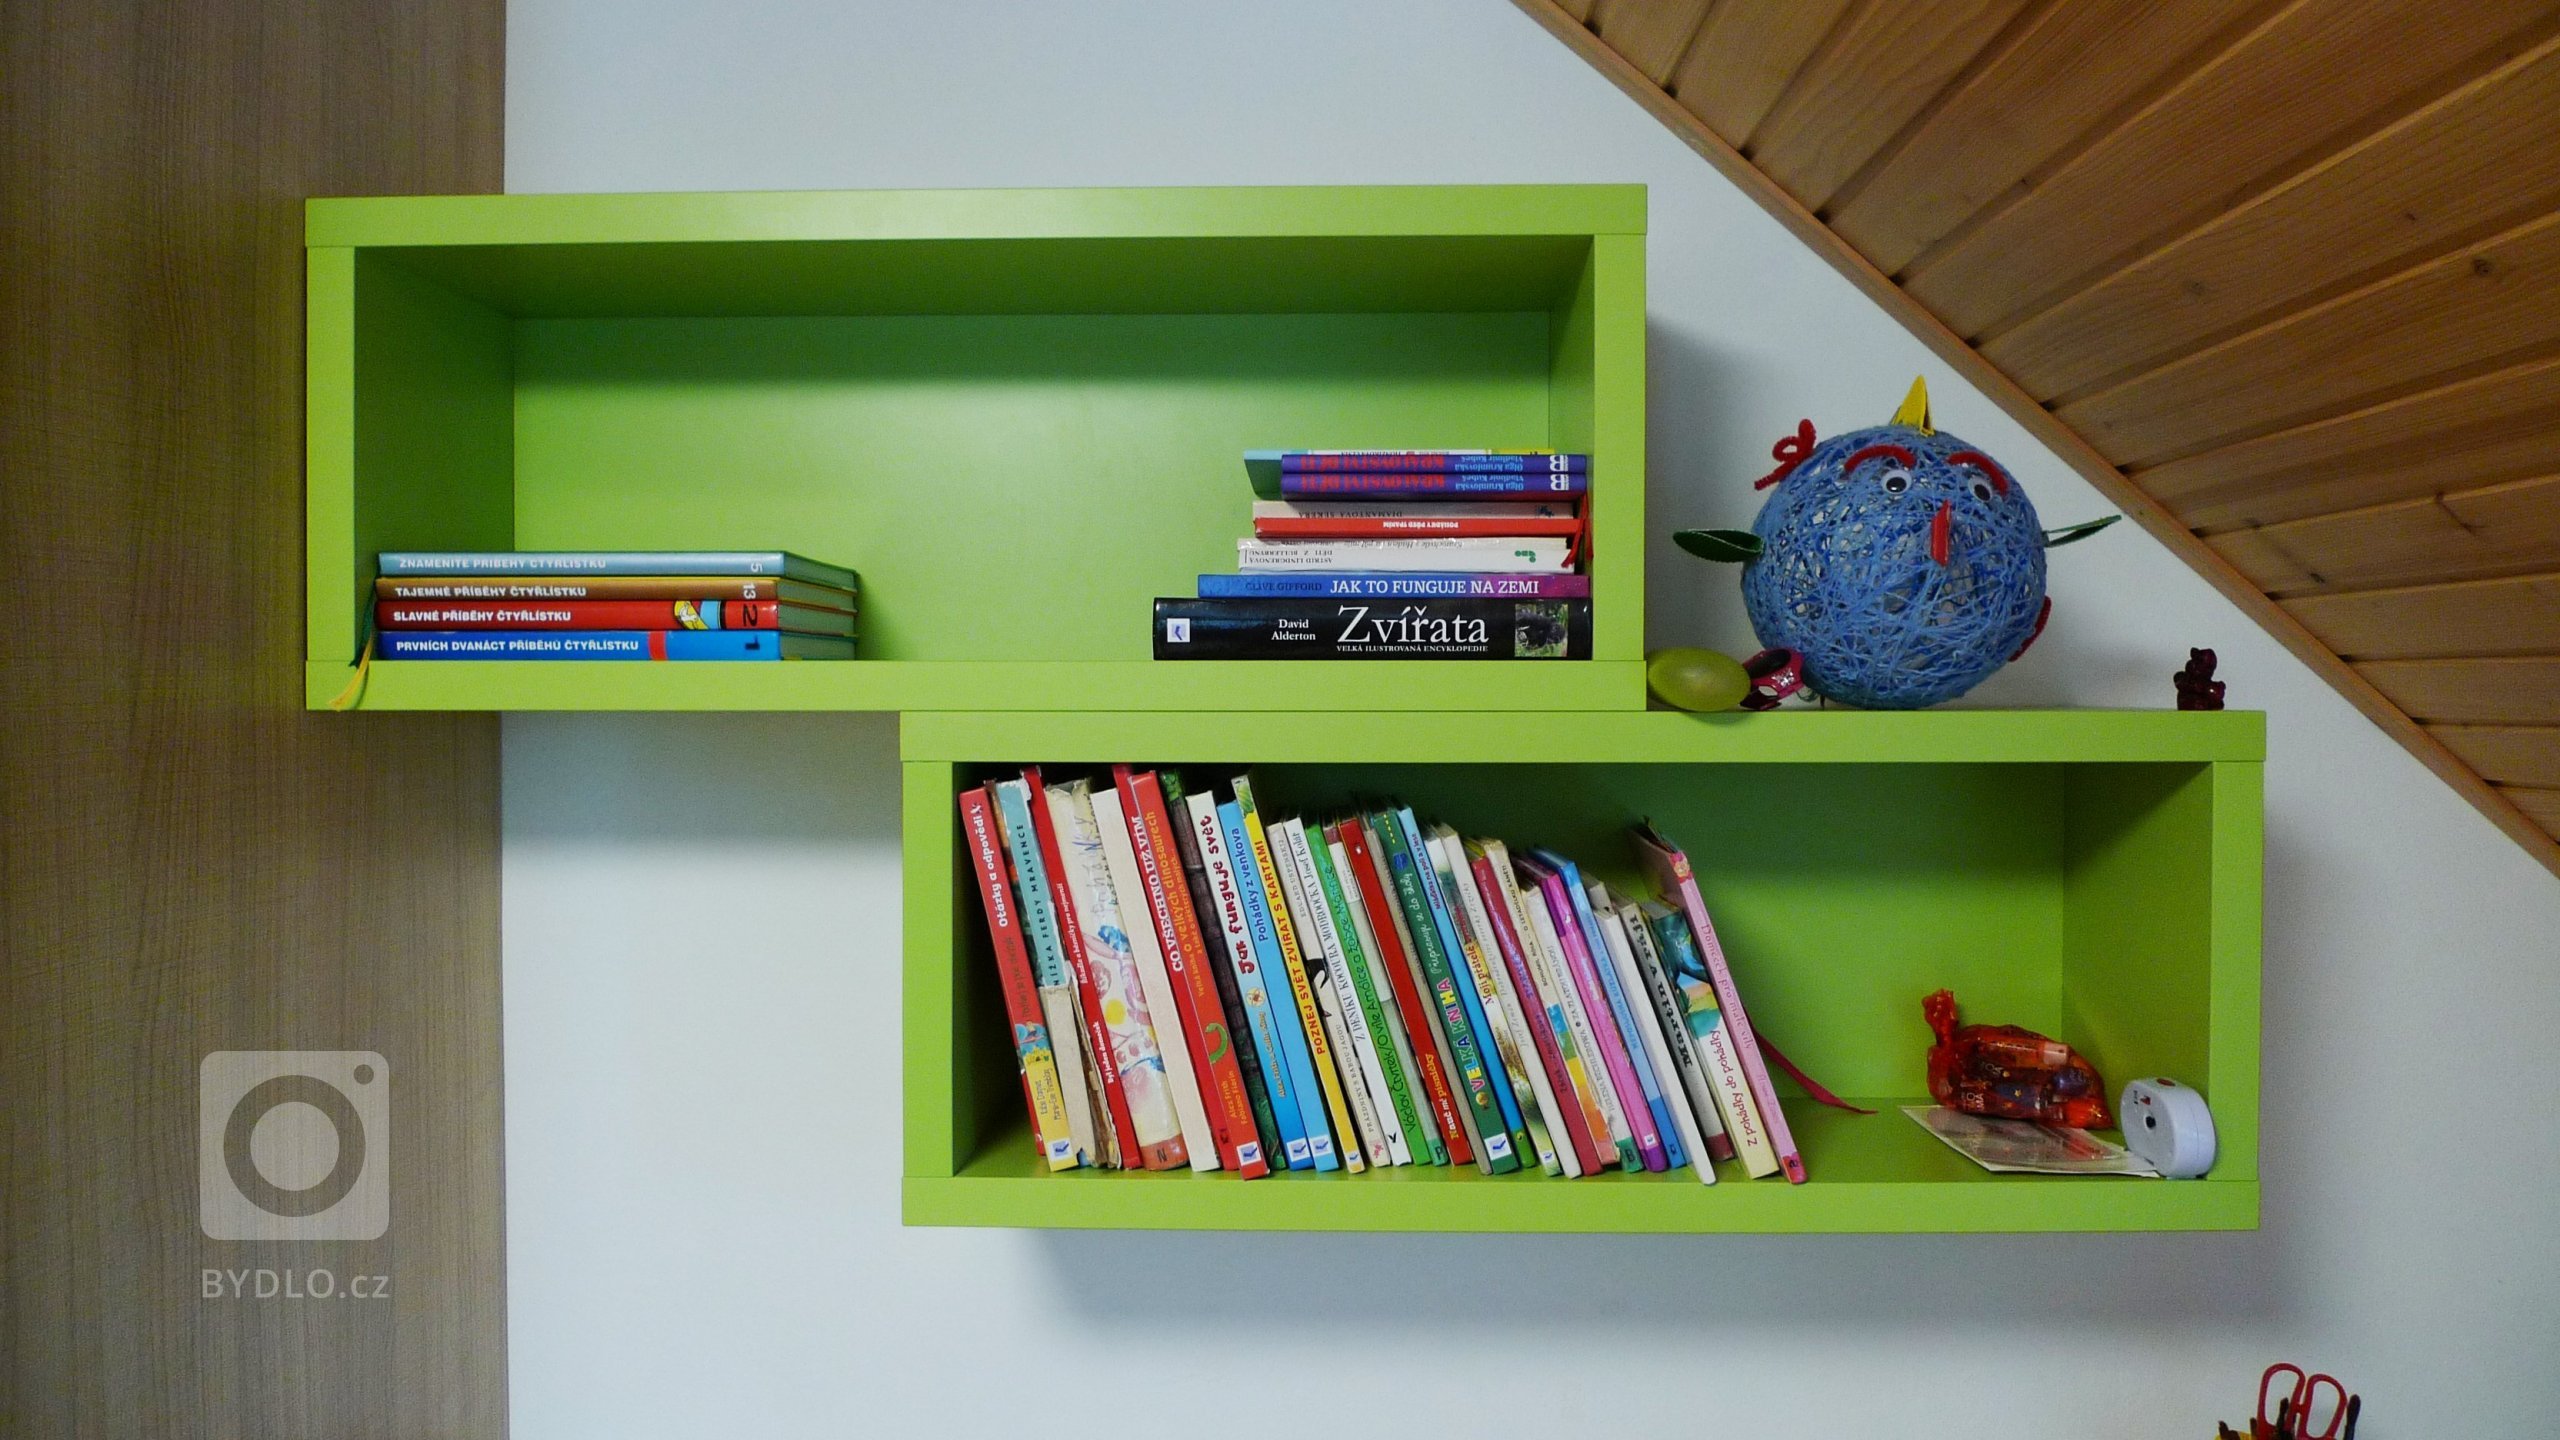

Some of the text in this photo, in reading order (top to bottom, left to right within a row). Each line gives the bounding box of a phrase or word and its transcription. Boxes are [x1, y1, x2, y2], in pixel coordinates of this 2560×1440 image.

[750, 562, 763, 573] 5
[395, 586, 587, 597] TAJEMNÉ PŘÍBĚHY ČTYŘLÍSTKU
[742, 584, 757, 599] 13
[1246, 583, 1322, 591] CLIVE GIFFORD
[1330, 580, 1539, 594] JAK TO FUNGUJE NA ZEMI
[393, 609, 571, 621] SLAVNÉ PŘÍBĚHY ČTYŘLÍSTKU
[742, 603, 758, 627] 2
[1279, 619, 1309, 628] David
[1337, 605, 1489, 644] Zvířata
[396, 640, 639, 651] PRVNÍCH DVANÁCT PŘÍBĚHŮ ČTYŘLÍSTKU
[1271, 631, 1316, 641] Alderton
[1336, 644, 1489, 652] VELKÁ ILUSTROVANÁ ENCYKLOPEDIE
[972, 813, 998, 870] odpovědi
[1144, 810, 1174, 889] dinosaurech
[1229, 826, 1251, 878] venkova
[989, 871, 998, 880] a
[1299, 856, 1313, 880] Josef
[1424, 870, 1431, 879] na
[989, 882, 1010, 927] Otázky
[1016, 822, 1060, 986] NÍŽKA FERDY MRAVENCE
[1130, 813, 1184, 971] CO VŠECHNO UŽ VÍM
[1198, 813, 1256, 975] Jak funguje svět
[1291, 884, 1307, 917] EDUARD
[1407, 896, 1420, 911] do
[1065, 911, 1074, 924] pro
[1166, 889, 1190, 940] velkých
[1245, 887, 1270, 941] Pohádky
[1254, 839, 1325, 1054] POZNEJ SVĚT ZVÍŘAT S KARTAMI
[1353, 954, 1362, 964] a
[1325, 941, 1349, 989] KOCOURA
[1464, 944, 1496, 1005] Moji přátelé
[1534, 957, 1549, 986] BOHUMIL
[1354, 964, 1377, 1011] Amálce
[1626, 913, 1694, 1067] Martin v ráji
[1718, 978, 1733, 999] pro
[1341, 991, 1362, 1031] DENÍKU
[1435, 976, 1466, 1034] KNIHA
[1570, 1008, 1580, 1019] ZA
[1092, 1019, 1114, 1083] Byl jeden domeček
[1355, 1033, 1365, 1041] Z
[1335, 1022, 1375, 1132] PRÁZDNINY BABOU JAGOU
[1452, 1033, 1486, 1093] VELKÁ
[1220, 1079, 1232, 1099] Frith
[1424, 1051, 1459, 1139] Nauč písničky
[1597, 1079, 1615, 1111] HELENA
[1706, 1027, 1758, 1146] Z pohádky do pohádky
[1397, 1091, 1418, 1131] Václav
[1157, 1148, 1168, 1162] N
